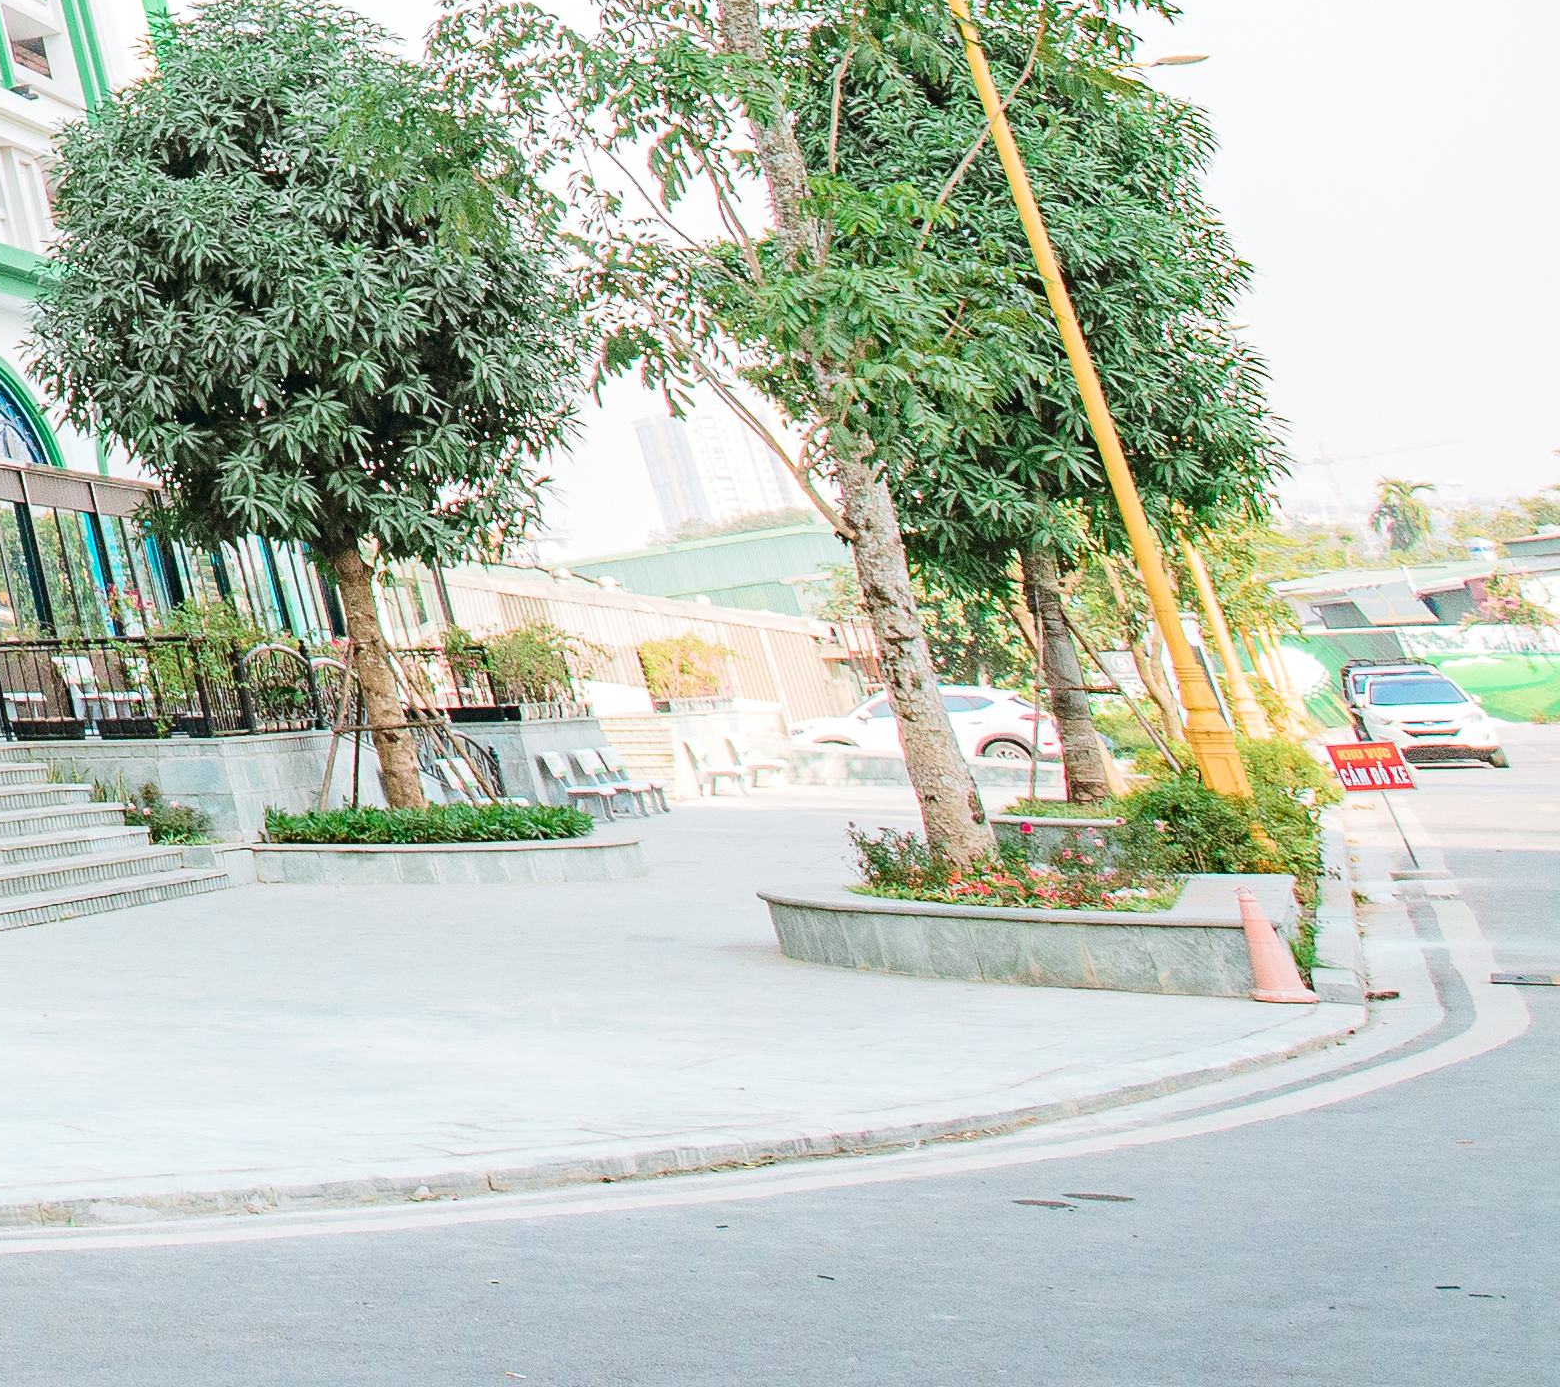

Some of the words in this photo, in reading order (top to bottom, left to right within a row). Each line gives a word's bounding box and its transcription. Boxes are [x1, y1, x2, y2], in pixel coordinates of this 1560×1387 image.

[1336, 749, 1364, 761] KHU
[1364, 747, 1392, 761] VỰC
[1339, 761, 1373, 786] CẤM
[1369, 760, 1391, 785] ĐỖ
[1389, 765, 1412, 785] XE
